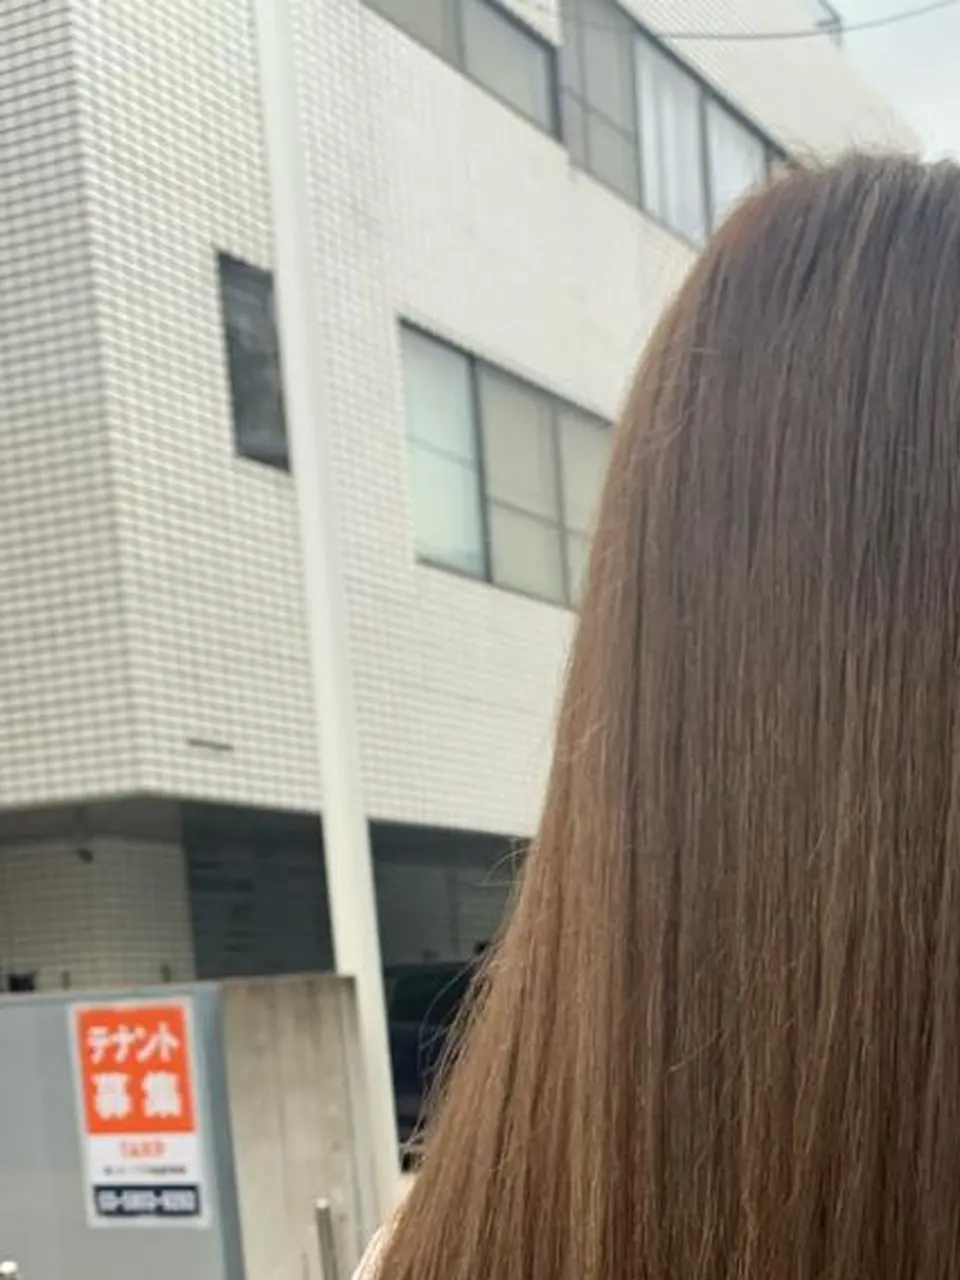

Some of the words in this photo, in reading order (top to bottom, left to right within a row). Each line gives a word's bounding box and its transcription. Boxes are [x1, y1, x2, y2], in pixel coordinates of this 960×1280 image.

[87, 1022, 180, 1064] テナント
[91, 1072, 182, 1120] 募集
